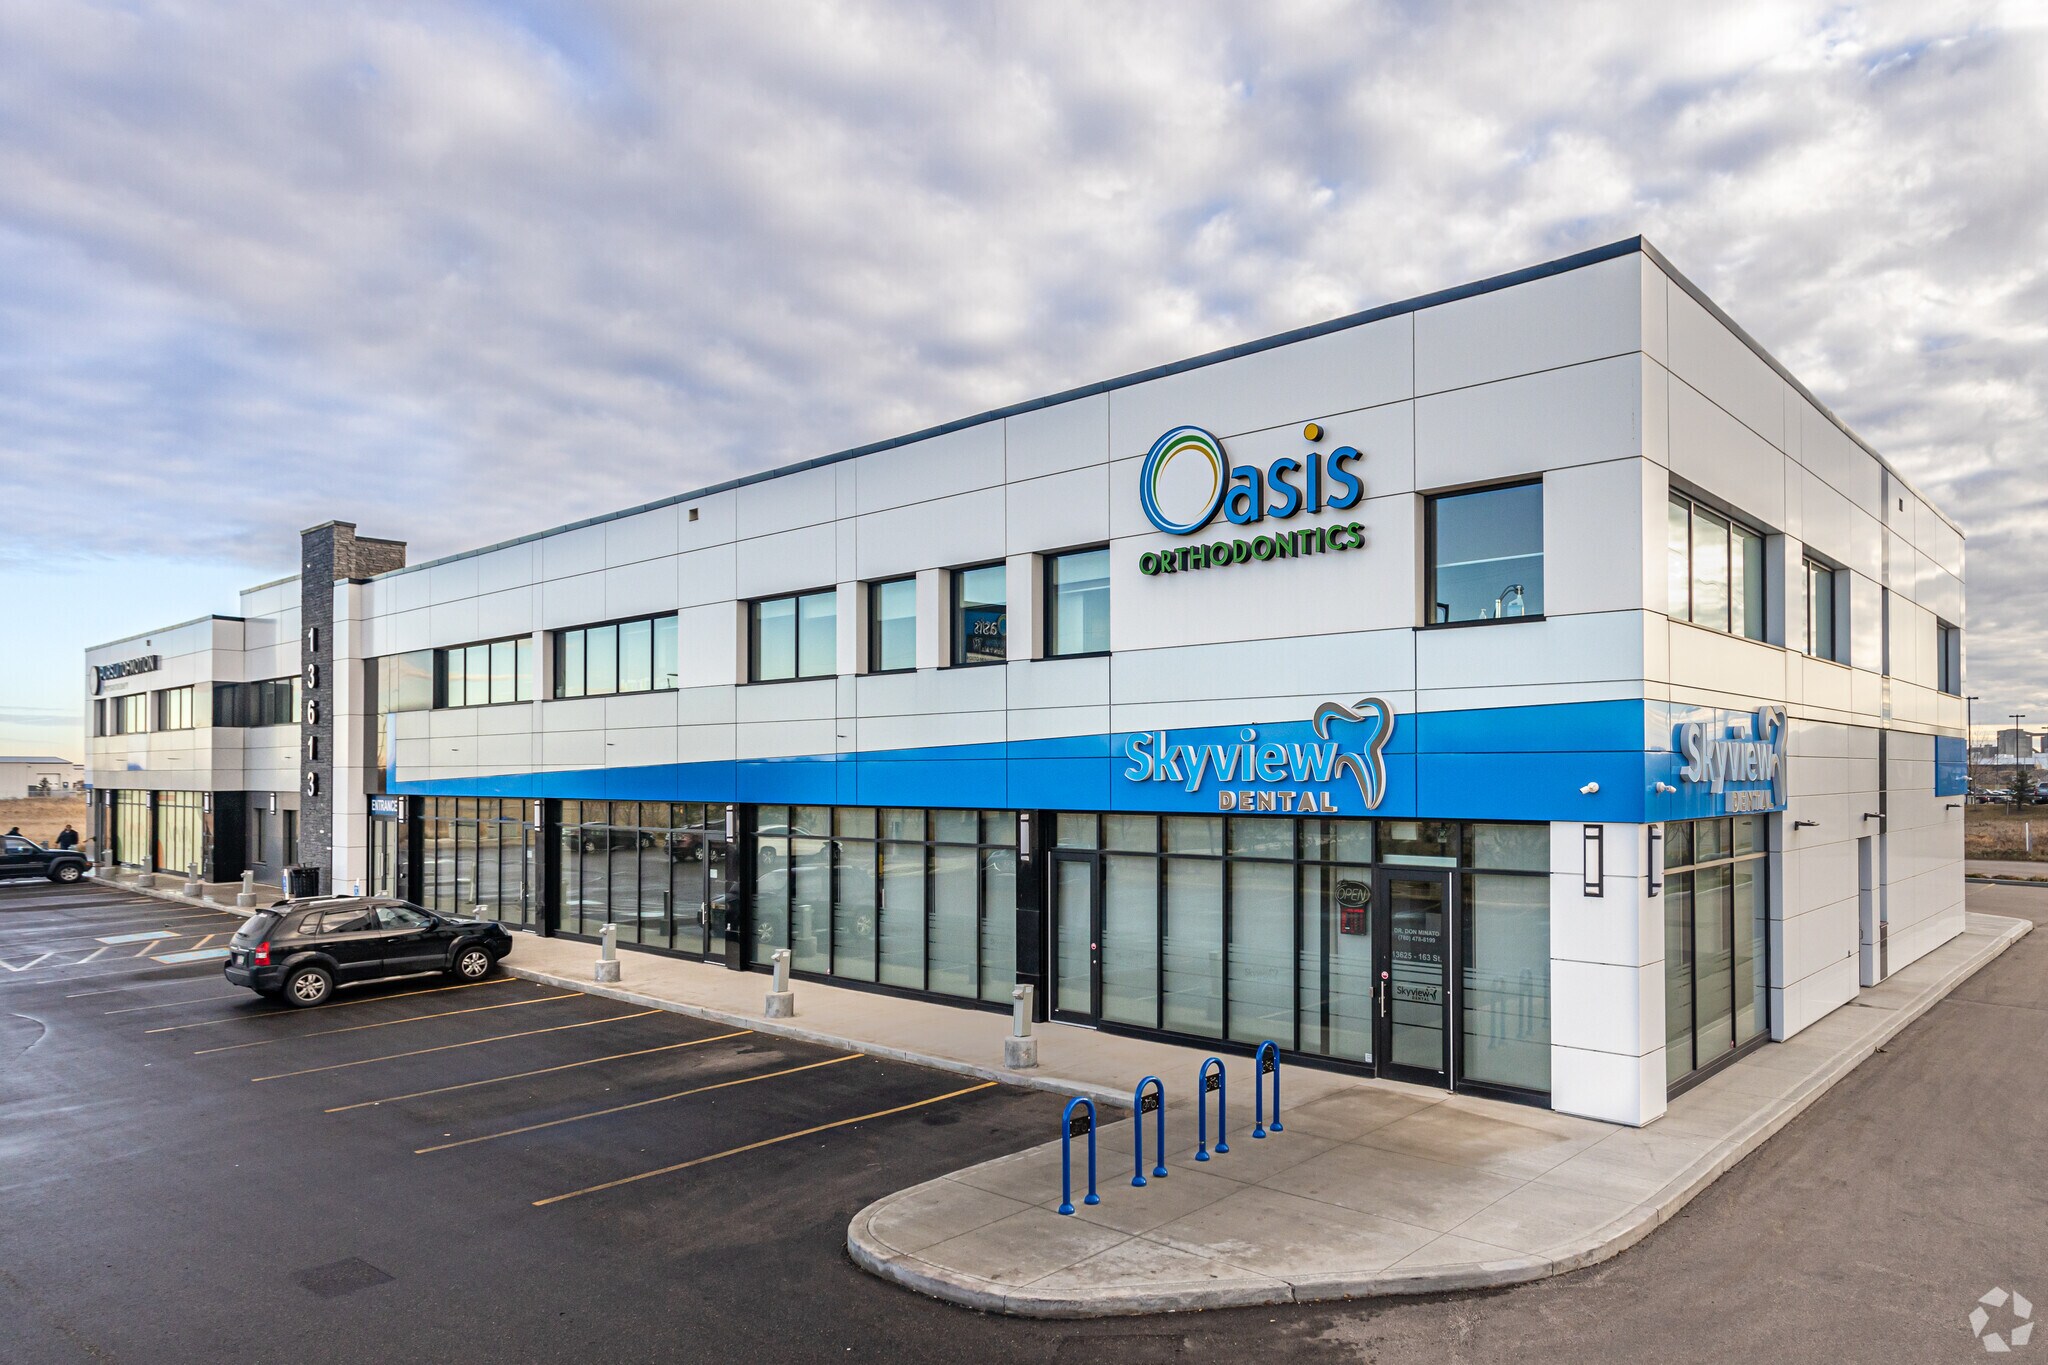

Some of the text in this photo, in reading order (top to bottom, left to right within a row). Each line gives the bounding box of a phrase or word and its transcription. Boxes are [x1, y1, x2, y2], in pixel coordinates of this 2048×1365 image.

[1140, 423, 1364, 535] Oasis
[1139, 522, 1365, 576] ORTHODONTICS
[307, 627, 319, 797] 13613
[1124, 728, 1338, 792] Skyview
[1680, 723, 1774, 793] Skyview
[371, 799, 398, 811] ENTRANCE
[1218, 790, 1338, 812] DENTAL
[1727, 789, 1774, 813] DENTAL
[1338, 888, 1367, 901] OPEN
[1392, 951, 1412, 959] 13625
[1418, 953, 1431, 961] 163
[1432, 954, 1443, 962] St.
[1397, 985, 1430, 997] Skyview
